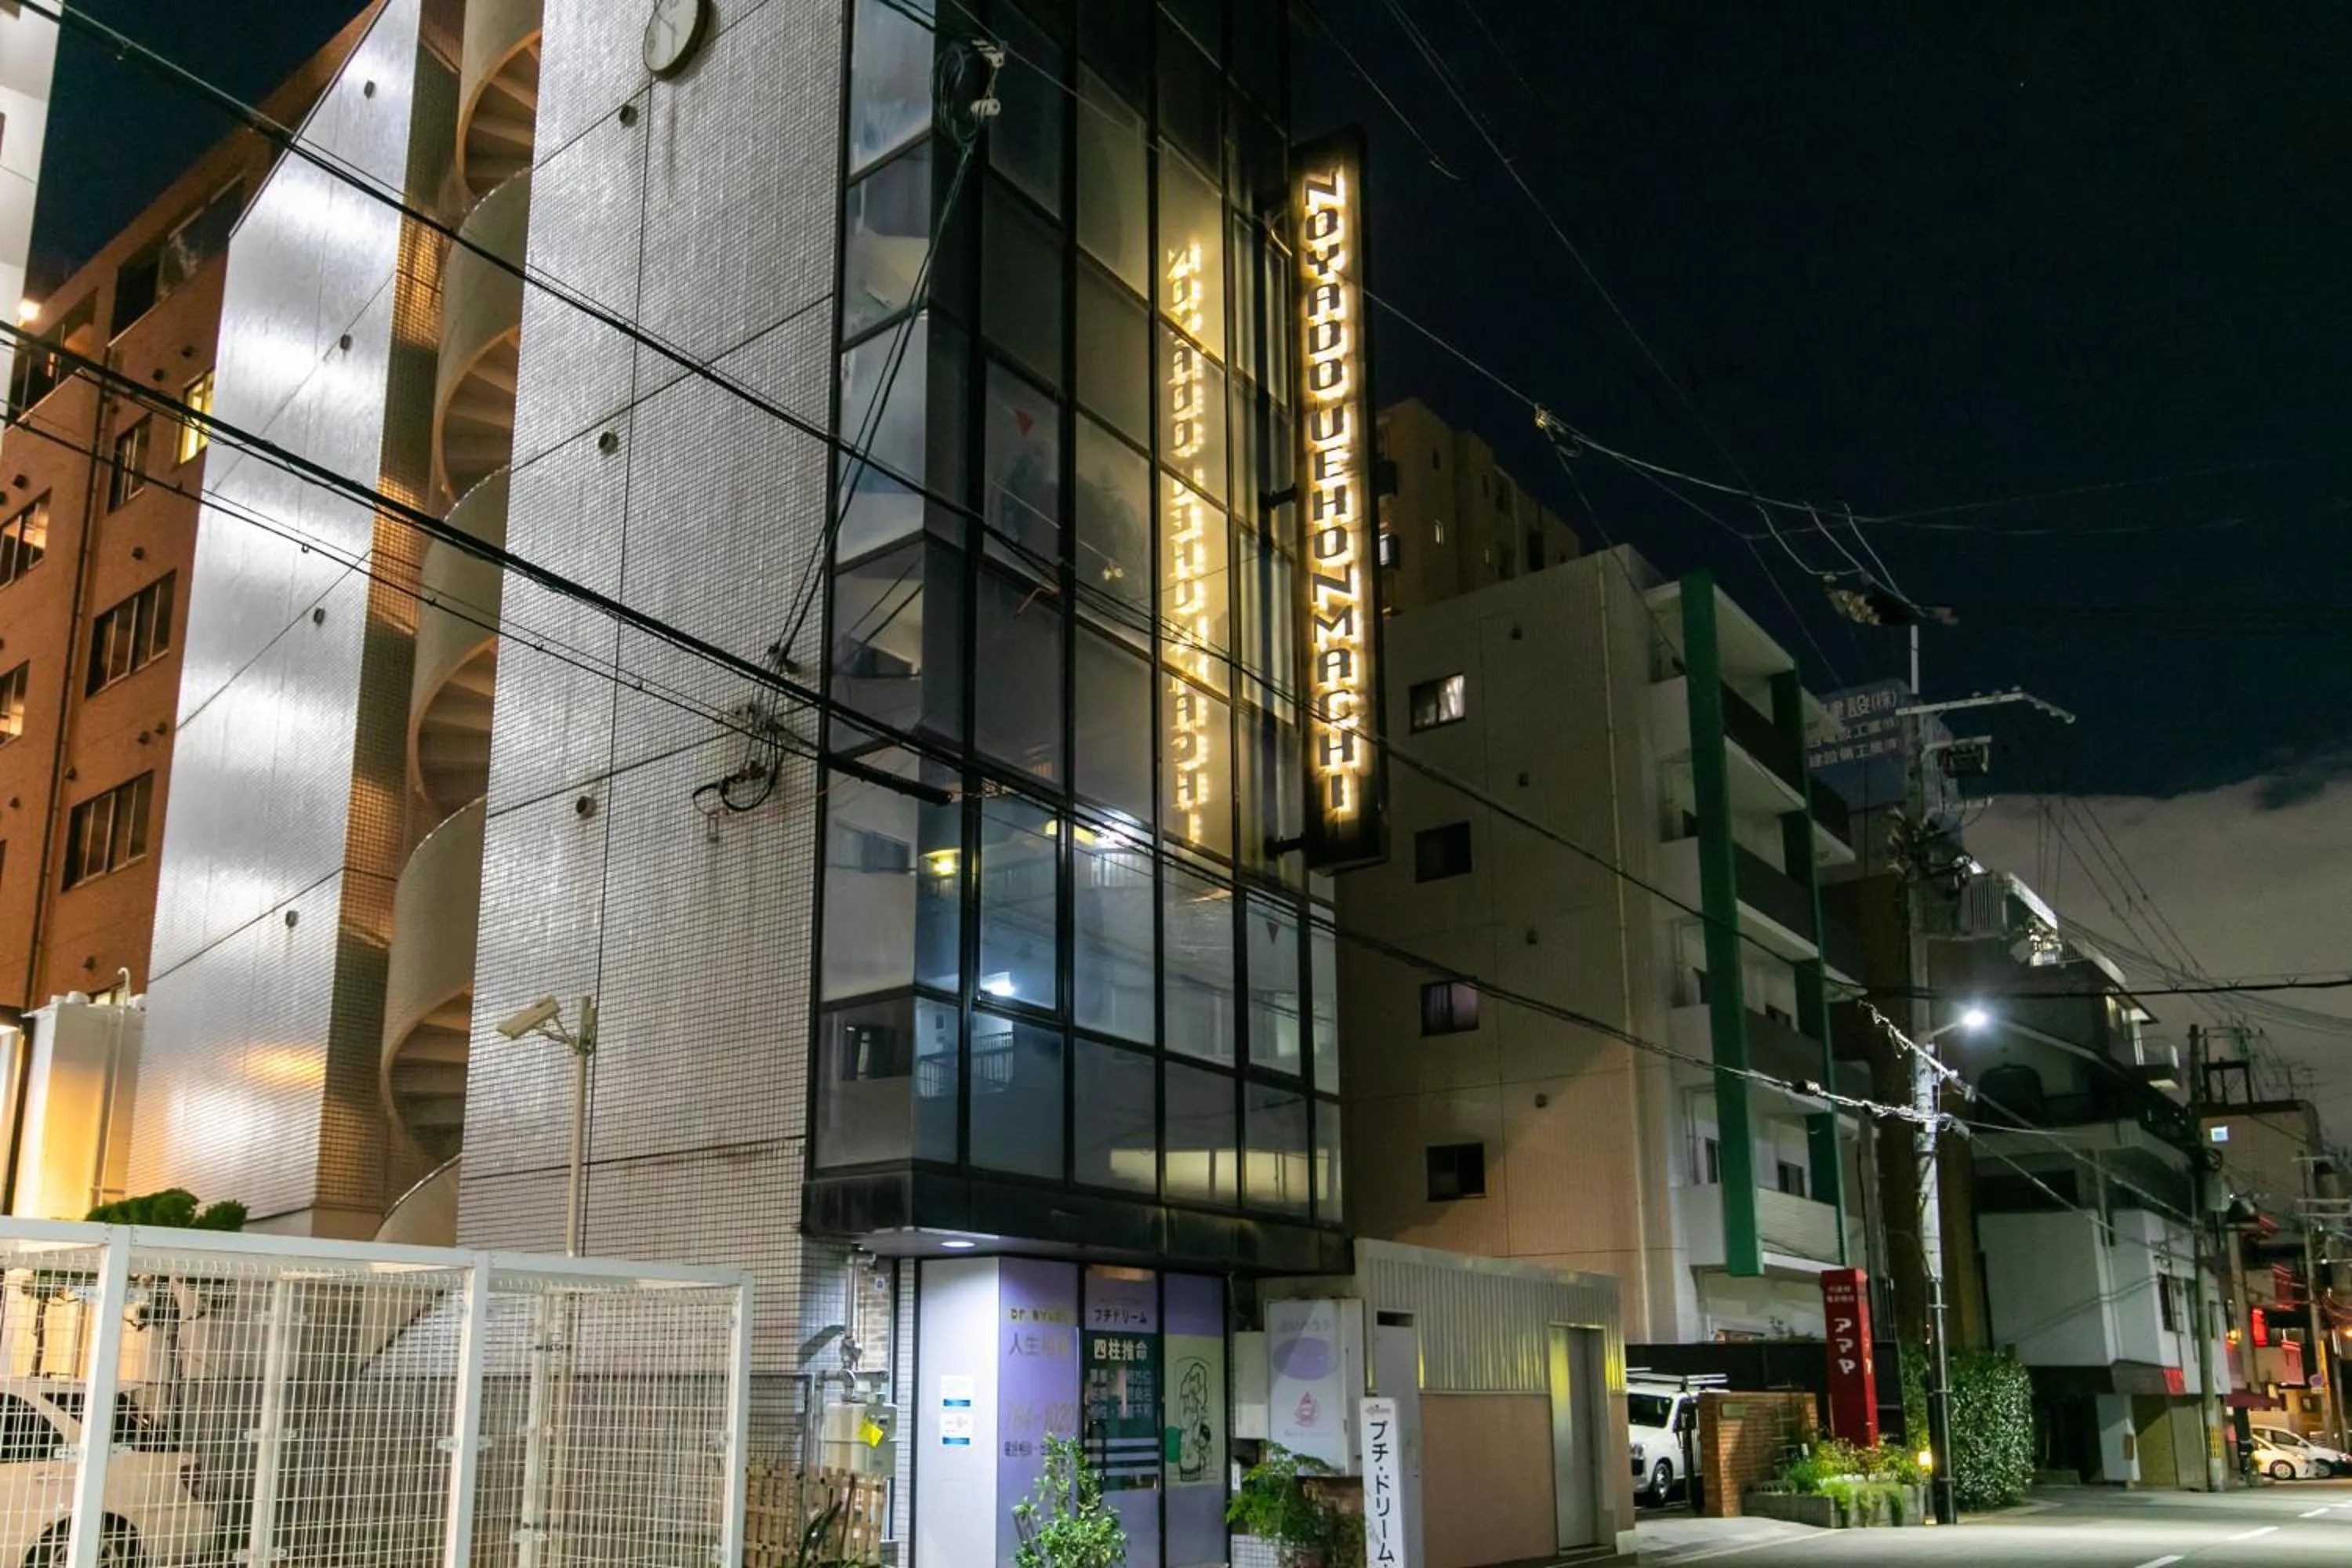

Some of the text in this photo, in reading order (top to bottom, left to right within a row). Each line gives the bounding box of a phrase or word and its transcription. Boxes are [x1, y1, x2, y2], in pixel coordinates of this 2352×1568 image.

[1304, 170, 1355, 809] NOYADO UEHONMACHI
[1094, 1338, 1148, 1361] 四柱推命
